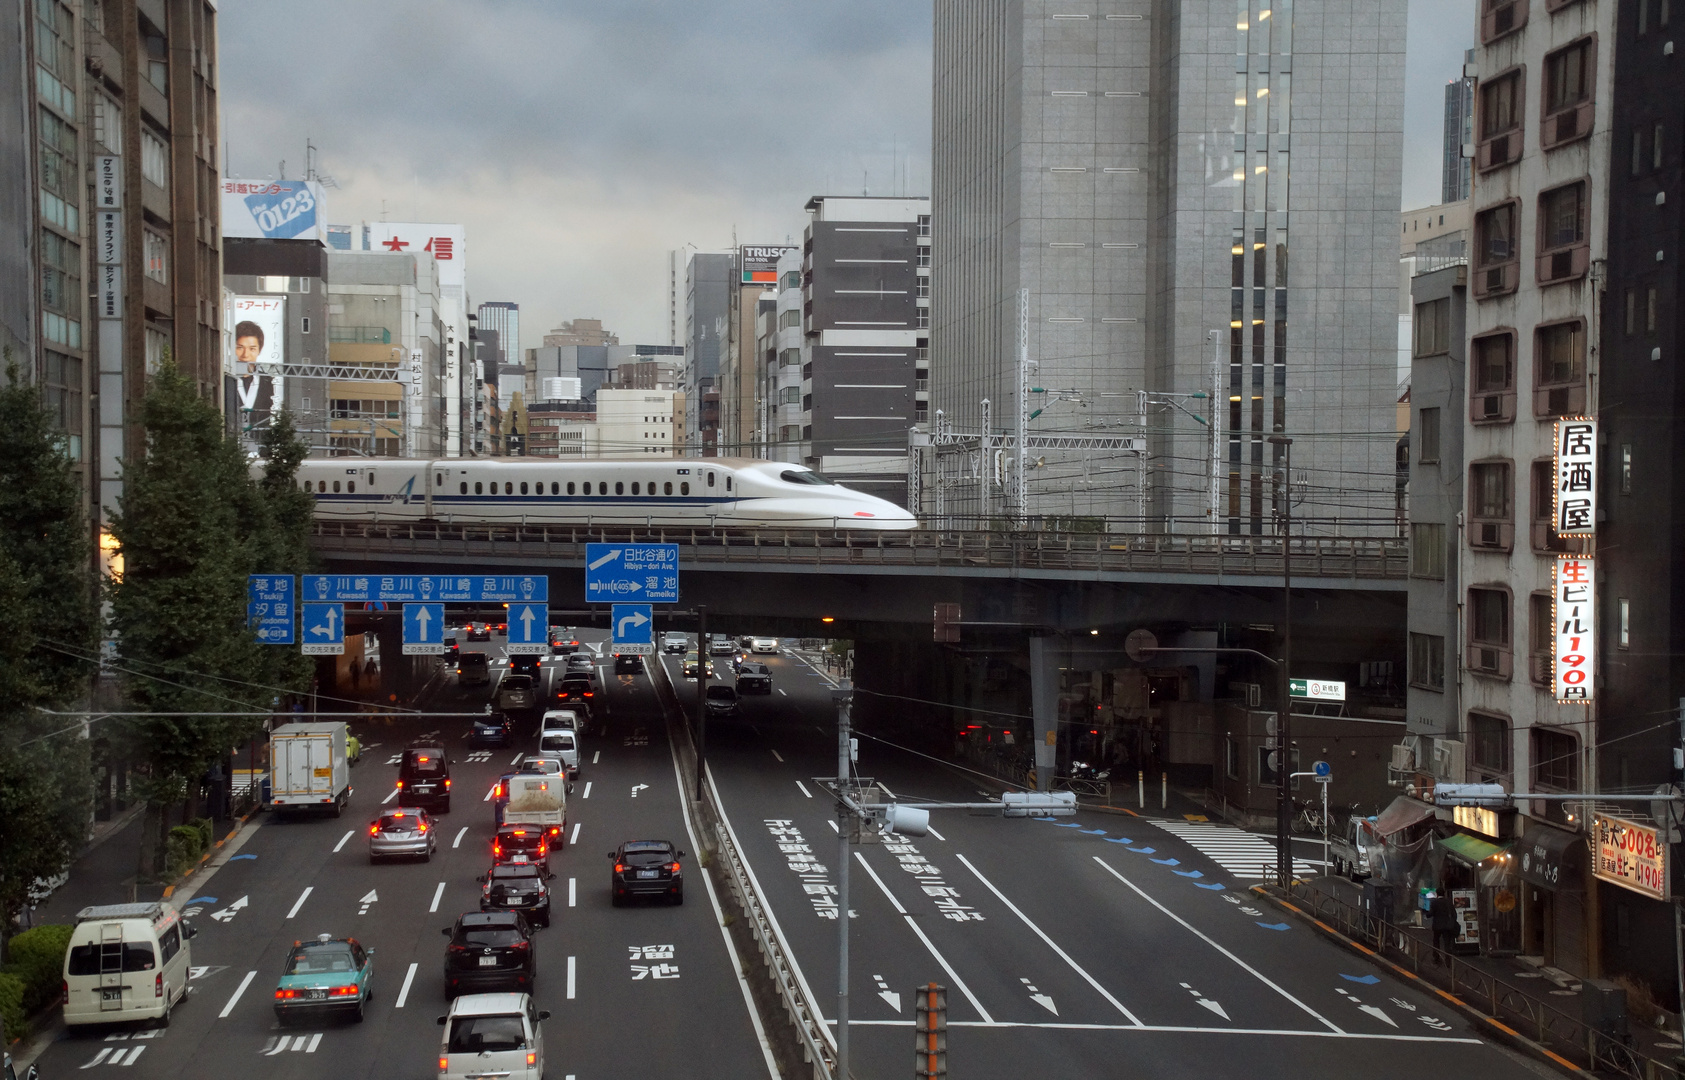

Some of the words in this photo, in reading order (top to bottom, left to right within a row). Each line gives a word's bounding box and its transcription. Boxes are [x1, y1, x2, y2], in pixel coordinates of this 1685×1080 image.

[103, 158, 112, 186] belle
[221, 182, 292, 195] 引越センター
[258, 189, 314, 232] 0123
[745, 247, 795, 257] TRUSC
[411, 353, 422, 396] 村松ビル
[1561, 424, 1593, 531] 居酒屋
[624, 548, 676, 562] 日比谷通り
[624, 562, 660, 571] Hibiya-dori
[661, 562, 675, 571] Ave.
[254, 578, 288, 592] 築地
[317, 582, 327, 591] 15
[336, 577, 369, 591] 川崎
[381, 577, 413, 591] 品川
[420, 582, 431, 591] 15
[439, 577, 471, 591] 川崎
[483, 577, 515, 591] 品川
[522, 582, 533, 591] 15
[645, 576, 676, 589] 溜池
[259, 592, 284, 601] Tsukiji
[379, 592, 414, 601] Shinagawa
[481, 592, 516, 601] Shinagawa
[645, 590, 676, 598] Tameike
[254, 603, 288, 616] 汐留
[1561, 561, 1590, 699] 生ビール190円
[628, 944, 680, 980] 溜池
